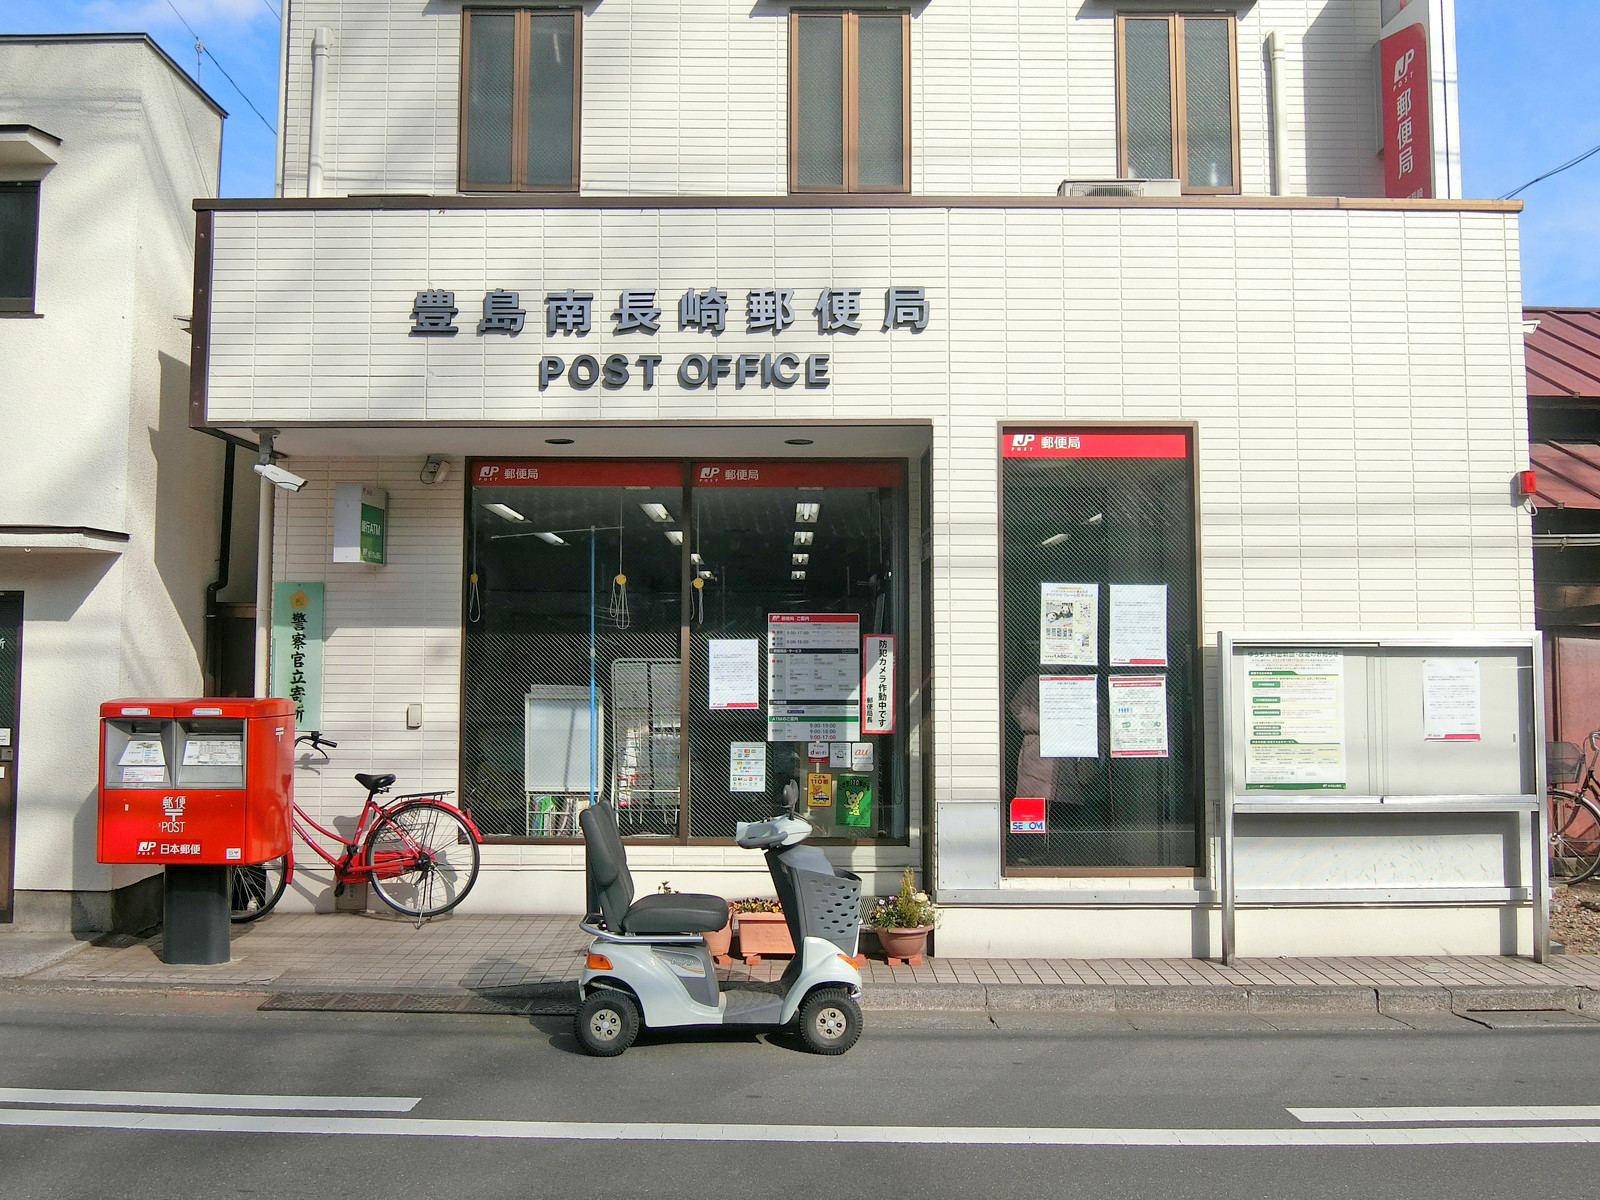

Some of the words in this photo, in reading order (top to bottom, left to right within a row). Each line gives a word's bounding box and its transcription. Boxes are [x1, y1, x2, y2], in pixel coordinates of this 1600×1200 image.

[1392, 71, 1415, 92] POST
[1396, 87, 1414, 180] 郵便局
[409, 286, 931, 335] 豊島南長崎郵便局
[538, 353, 661, 391] POST
[677, 352, 831, 390] OFFICE
[1041, 436, 1081, 450] 郵便局
[504, 468, 539, 480] 郵便局
[724, 469, 759, 481] 郵便局
[878, 640, 888, 727] 防犯カメラ作動中です
[866, 697, 874, 724] 郵便局長
[162, 796, 186, 810] 郵便
[161, 821, 186, 833] POST
[1012, 821, 1043, 830] SECOM
[160, 843, 201, 855] 日本郵便
